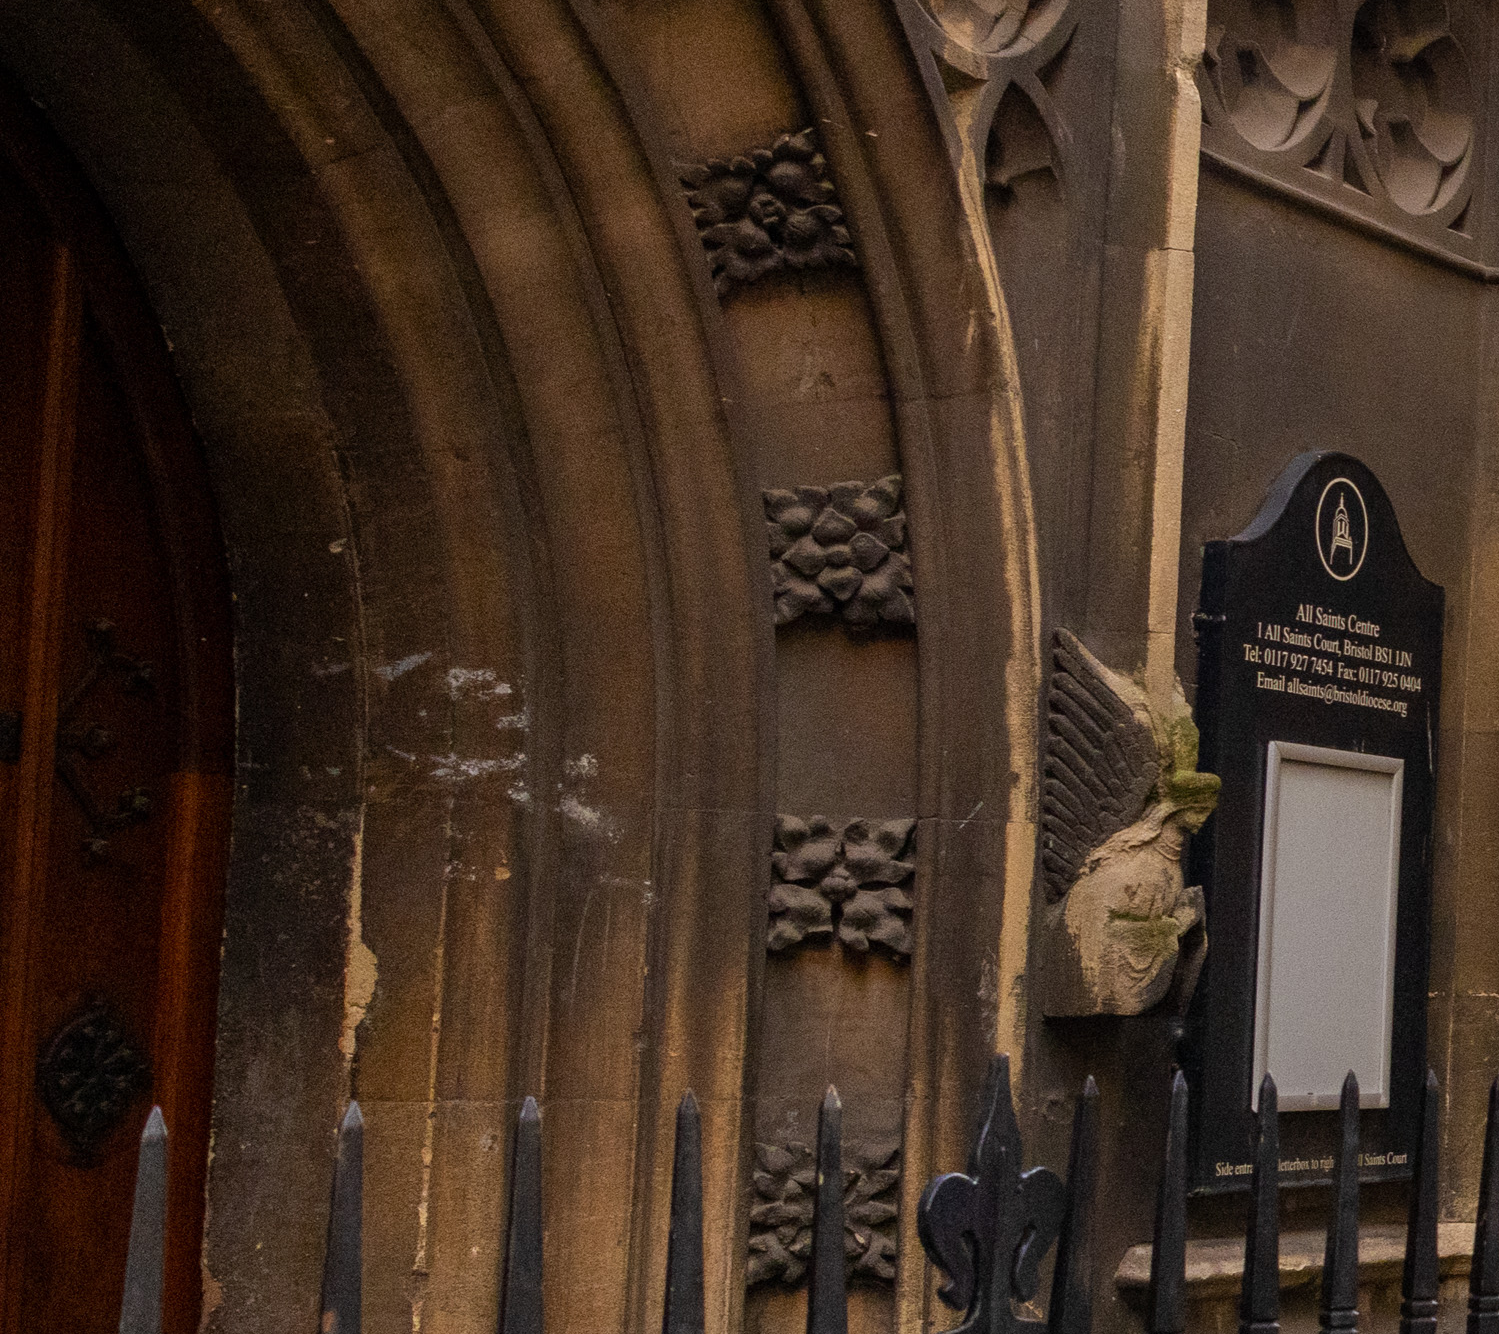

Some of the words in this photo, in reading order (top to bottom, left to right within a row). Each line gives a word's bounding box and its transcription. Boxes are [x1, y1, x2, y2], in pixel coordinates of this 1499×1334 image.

[1296, 603, 1313, 623] All
[1315, 607, 1346, 630] Saints
[1348, 615, 1380, 637] Centre
[1258, 622, 1262, 638] 1
[1264, 624, 1280, 642] All
[1283, 627, 1311, 647] Saints
[1313, 633, 1341, 657] Court,
[1343, 639, 1373, 660] Bristol
[1375, 646, 1392, 664] BS1
[1395, 650, 1413, 667] 1JN
[1243, 643, 1262, 663] Tel:
[1264, 648, 1288, 667] 0117
[1290, 653, 1308, 671] 927
[1311, 657, 1333, 676] 7454
[1338, 662, 1357, 681] Fax:
[1359, 666, 1380, 685] 0117
[1382, 671, 1399, 688] 925
[1400, 675, 1421, 693] 0404
[1257, 671, 1285, 691] Email
[1287, 677, 1408, 718] allsaints@bristoldiocese.org
[1216, 1162, 1233, 1177] Side
[1311, 1159, 1319, 1169] to
[1364, 1153, 1386, 1166] Saints
[1387, 1151, 1407, 1164] Court
